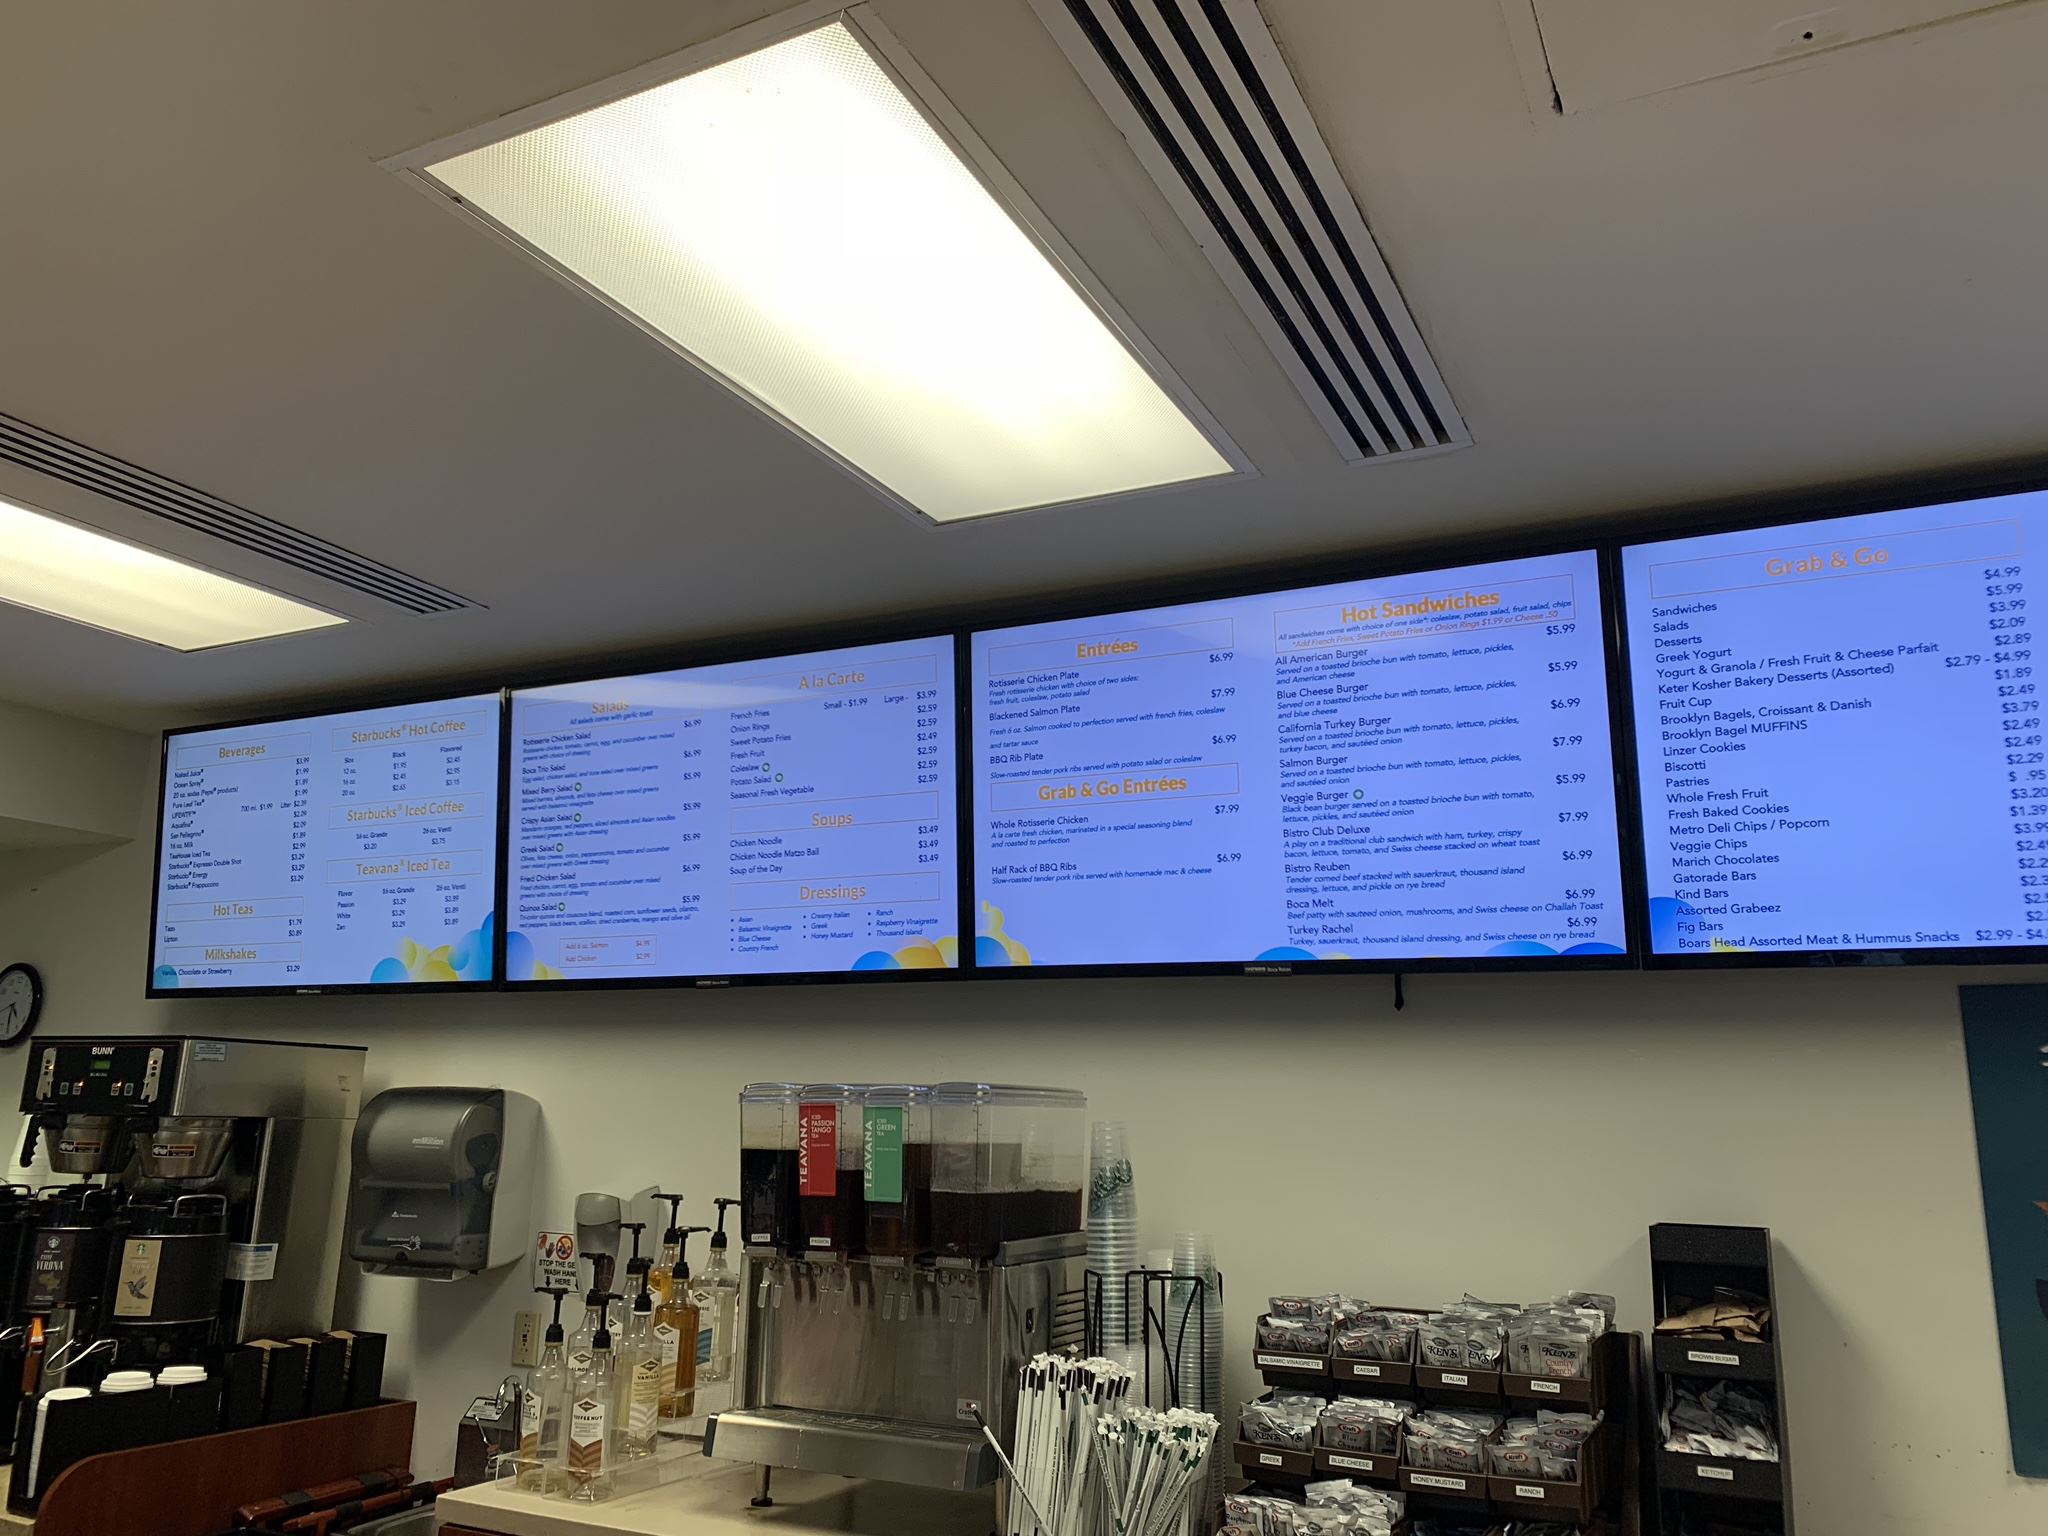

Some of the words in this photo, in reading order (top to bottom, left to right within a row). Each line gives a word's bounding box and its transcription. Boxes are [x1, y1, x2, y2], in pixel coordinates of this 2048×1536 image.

[1765, 556, 1824, 576] Grab
[1830, 552, 1847, 568] &
[1853, 547, 1888, 566] Go
[1984, 566, 2020, 580] $4.99
[1985, 582, 2022, 596] $5.99
[1342, 606, 1378, 624] Hot
[1382, 592, 1500, 618] Sandwiches
[1651, 603, 1717, 617] Sandwiches
[1546, 623, 1575, 635] $5.99
[1652, 620, 1689, 632] Salads
[1076, 638, 1139, 660] Entrées
[1654, 636, 1702, 648] Desserts
[1209, 652, 1233, 663] $6.99
[1274, 656, 1287, 666] All
[1289, 653, 1333, 664] American
[1335, 649, 1368, 659] Burger
[1655, 651, 1690, 663] Greek
[1692, 648, 1732, 660] Yogurt
[1655, 667, 1695, 680] Yogurt
[1698, 664, 1707, 675] &
[1710, 660, 1756, 673] Granola
[1759, 658, 1764, 669] /
[1767, 655, 1800, 667] Fresh
[1803, 653, 1831, 664] Fruit
[1834, 651, 1844, 661] &
[1847, 649, 1894, 660] Cheese
[1897, 642, 1939, 654] Parfait
[799, 676, 809, 689] A
[812, 674, 824, 688] la
[827, 671, 865, 686] Carte
[988, 677, 1025, 688] Rotisserie
[1026, 674, 1058, 683] Chicken
[1059, 671, 1079, 680] Plate
[1658, 684, 1689, 694] Keter
[1691, 679, 1731, 691] Kosher
[1734, 676, 1774, 687] Bakery
[1777, 671, 1828, 683] Desserts
[1831, 663, 1894, 679] (Assorted)
[916, 689, 936, 700] $3.99
[1276, 690, 1296, 699] Blue
[1299, 687, 1334, 697] Cheese
[1336, 684, 1368, 694] Burger
[917, 703, 937, 713] $2.59
[1659, 698, 1685, 709] Fruit
[1688, 696, 1712, 708] Cup
[408, 724, 429, 736] Hot
[430, 720, 466, 734] Coffee
[1277, 722, 1321, 733] California
[1323, 719, 1356, 729] Turkey
[1358, 717, 1391, 727] Burger
[1662, 728, 1711, 740] Brooklyn
[1714, 724, 1747, 738] Bagel
[1750, 718, 1808, 733] MUFFINS
[218, 744, 266, 758] Beverages
[1663, 746, 1696, 756] Linzer
[1699, 742, 1746, 753] Cookies
[989, 754, 1008, 764] BBQ
[1009, 754, 1022, 762] Rib
[1024, 752, 1043, 760] Plate
[1664, 760, 1706, 772] Biscotti
[1039, 785, 1077, 800] Grab
[1080, 783, 1092, 798] &
[1096, 781, 1120, 796] Go
[1123, 774, 1188, 794] Entrées
[1665, 777, 1710, 787] Pastries
[811, 812, 854, 828] Soups
[990, 820, 1015, 829] Whole
[1017, 818, 1054, 827] Rotisserie
[1056, 816, 1088, 824] Chicken
[407, 858, 429, 873] Iced
[430, 857, 451, 871] Tea
[1284, 864, 1311, 873] Bistro
[1314, 862, 1350, 871] Reuben
[800, 884, 867, 902] Dressings
[213, 904, 230, 916] Hot
[232, 902, 254, 915] Teas
[1286, 899, 1309, 909] Boca
[1312, 898, 1334, 908] Melt
[1678, 938, 1711, 949] Boars
[1714, 936, 1745, 946] Head
[1748, 935, 1802, 946] Assorted
[1806, 934, 1838, 944] Meat
[1841, 933, 1852, 944] &
[1855, 933, 1912, 943] Hummus
[1915, 931, 1960, 942] Snacks
[204, 947, 257, 961] Milkshakes
[800, 1117, 808, 1185] TEAVANA
[864, 1120, 873, 1190] TEAVANA
[36, 1260, 63, 1271] VERONA
[1356, 1366, 1378, 1374] CAESAR
[1444, 1376, 1466, 1384] ITALIAN
[1533, 1382, 1558, 1390] FRENCH
[1262, 1455, 1280, 1464] GREEK
[1330, 1455, 1346, 1463] BLUE
[1347, 1458, 1370, 1468] CHEESE
[1412, 1476, 1434, 1484] HONEY
[1434, 1478, 1464, 1488] MUSTARD
[1520, 1488, 1541, 1496] RANCH
